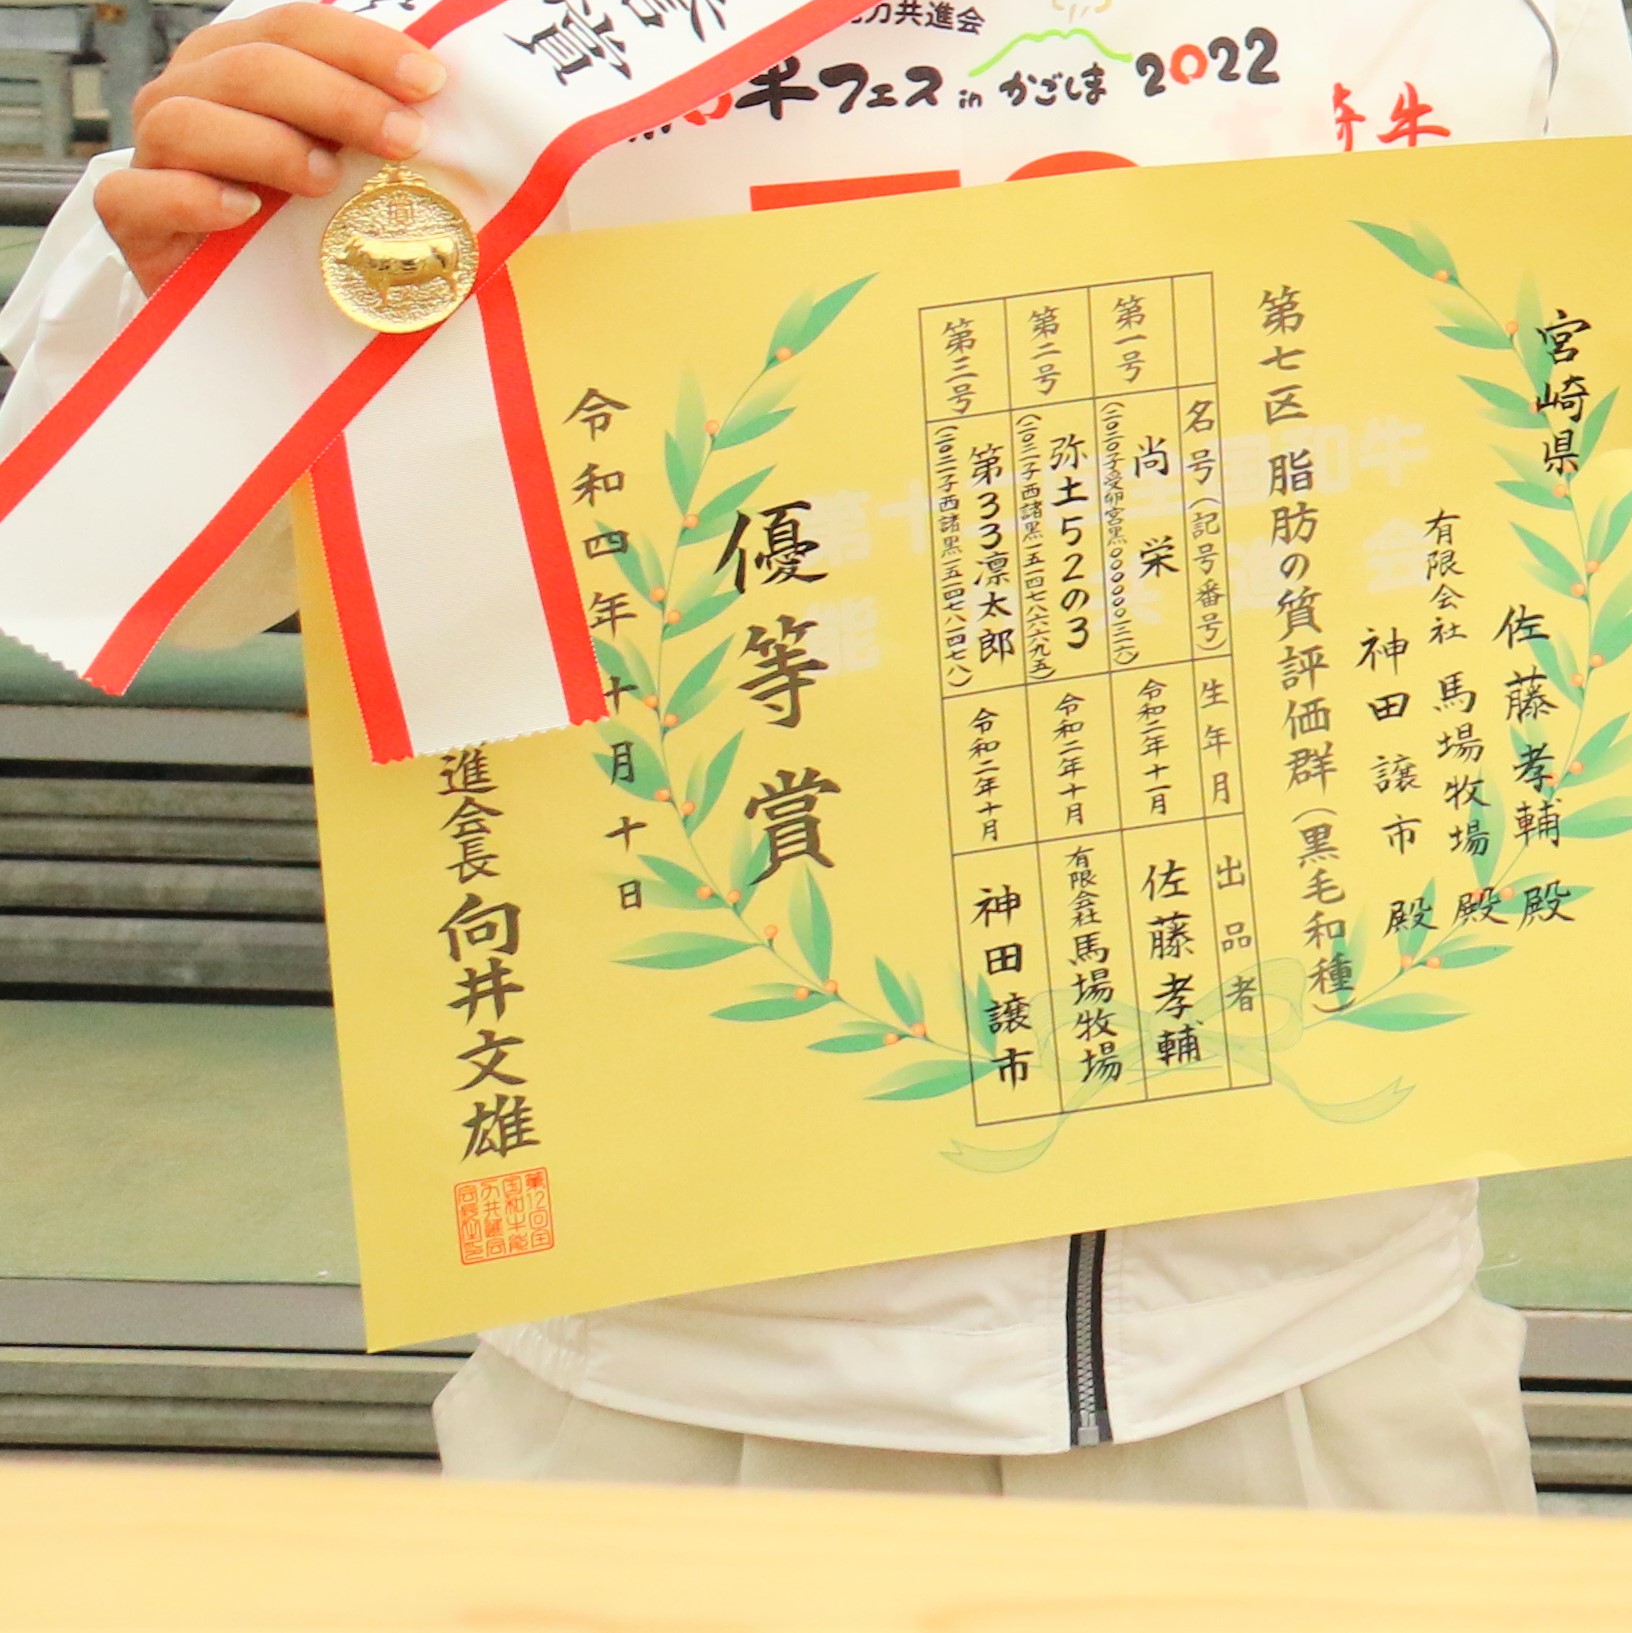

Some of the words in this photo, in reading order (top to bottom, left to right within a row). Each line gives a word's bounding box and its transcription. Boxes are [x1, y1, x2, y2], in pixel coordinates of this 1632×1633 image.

[958, 89, 983, 109] in
[1001, 62, 1108, 109] かごしま
[1136, 27, 1280, 97] 2022
[942, 317, 979, 415] 第三号
[1028, 304, 1062, 396] 第二号
[1112, 293, 1148, 384] 第一号
[1258, 283, 1309, 426] 第七区
[1534, 309, 1593, 475] 宮崎県
[1424, 507, 1468, 647] 有限会社
[563, 387, 648, 911] 令和四年十月十日
[714, 500, 842, 886] 優等賞
[968, 707, 1004, 841] 令和二年十月
[1053, 692, 1088, 826] 令和二年十月
[1137, 677, 1172, 817] 令和二年十一月
[1200, 677, 1233, 805] 生年月
[1355, 625, 1424, 856] 神田譲市
[1431, 674, 1493, 859] 馬場牧場
[1492, 604, 1564, 850] 佐藤孝輔
[1141, 858, 1204, 1068] 佐藤孝輔
[1215, 854, 1258, 1013] 出品者
[1383, 898, 1440, 936] 殿
[1453, 883, 1509, 930] 殿
[1517, 879, 1577, 933] 殿
[438, 892, 541, 1162] 向井文雄
[971, 884, 1034, 1091] 神田譲市
